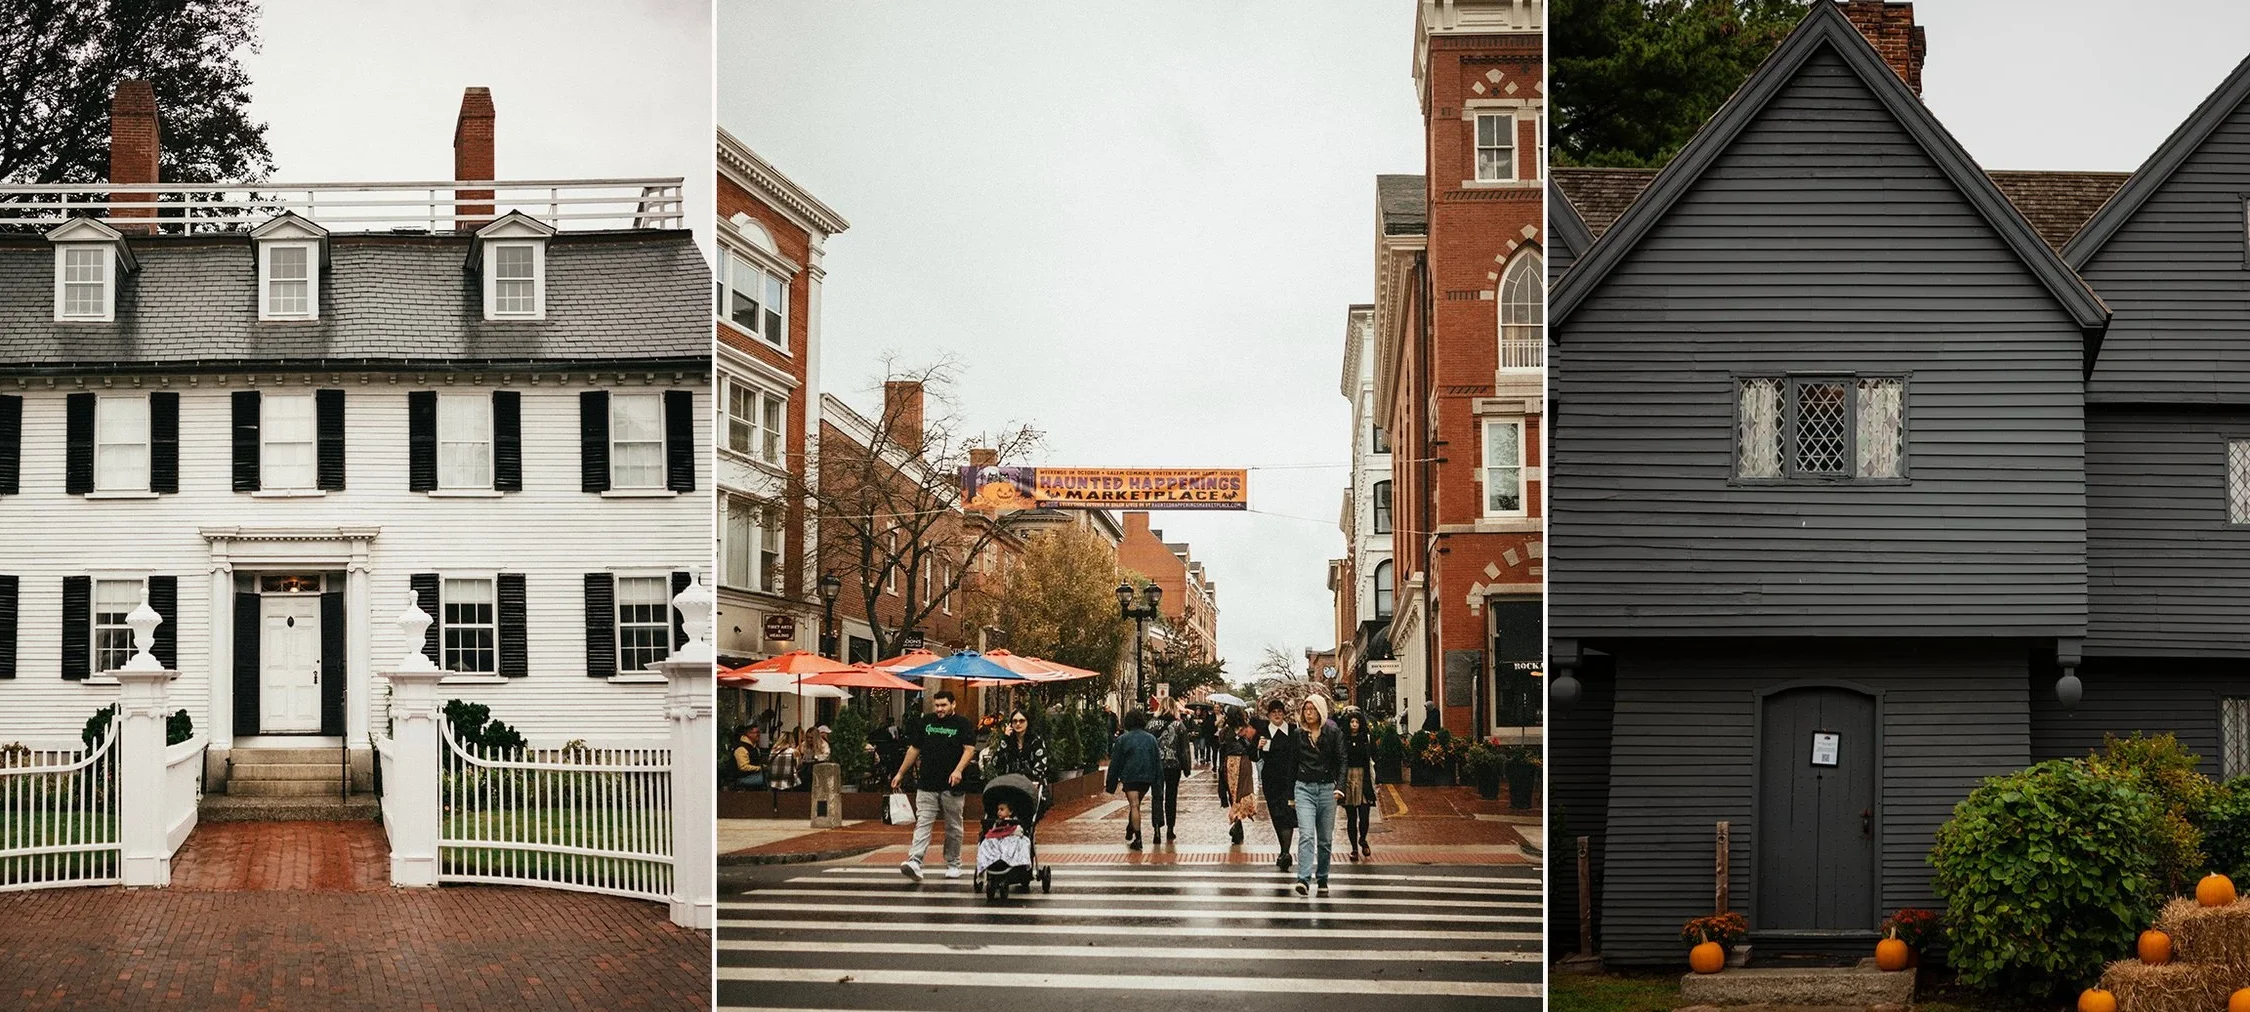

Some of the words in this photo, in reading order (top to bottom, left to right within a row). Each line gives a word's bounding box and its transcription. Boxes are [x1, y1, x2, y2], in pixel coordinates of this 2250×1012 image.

[1040, 476, 1123, 489] HAUNTED
[1129, 476, 1240, 490] HAPPENINGS
[1065, 490, 1218, 500] MARKETPLACE
